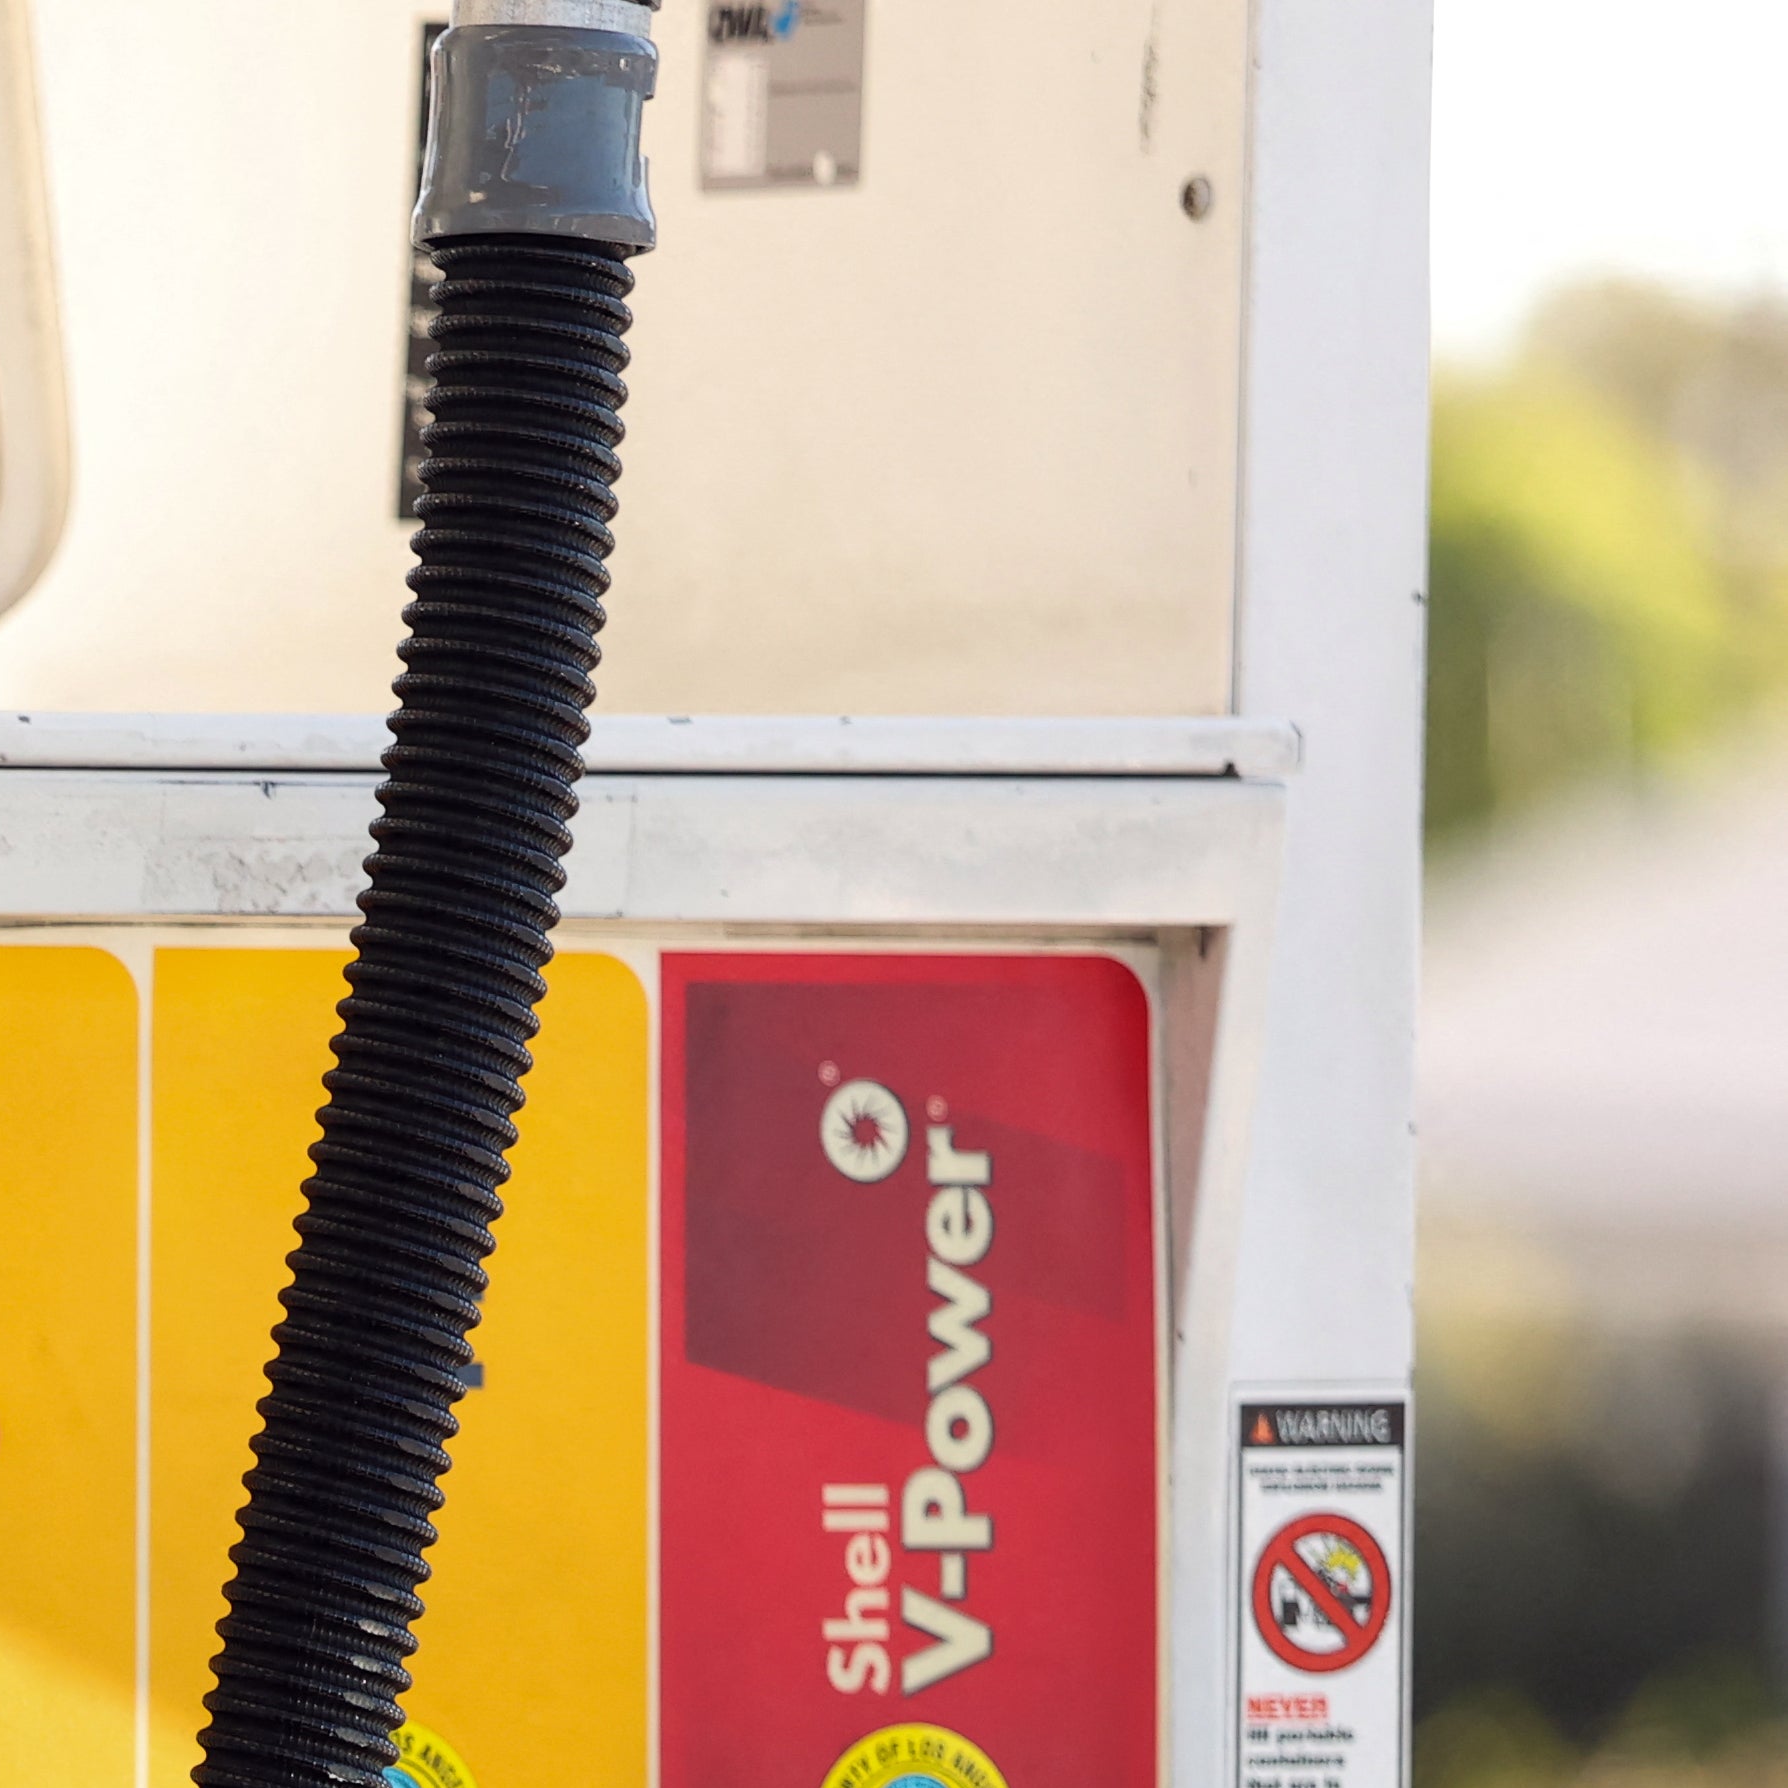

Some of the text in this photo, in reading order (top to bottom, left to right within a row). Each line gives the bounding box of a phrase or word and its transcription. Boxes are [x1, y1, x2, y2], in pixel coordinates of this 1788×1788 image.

[901, 1127, 994, 1695] V-Power
[1276, 1408, 1391, 1443] WARNING
[823, 1484, 891, 1695] Shell
[1248, 1697, 1328, 1716] NEVER
